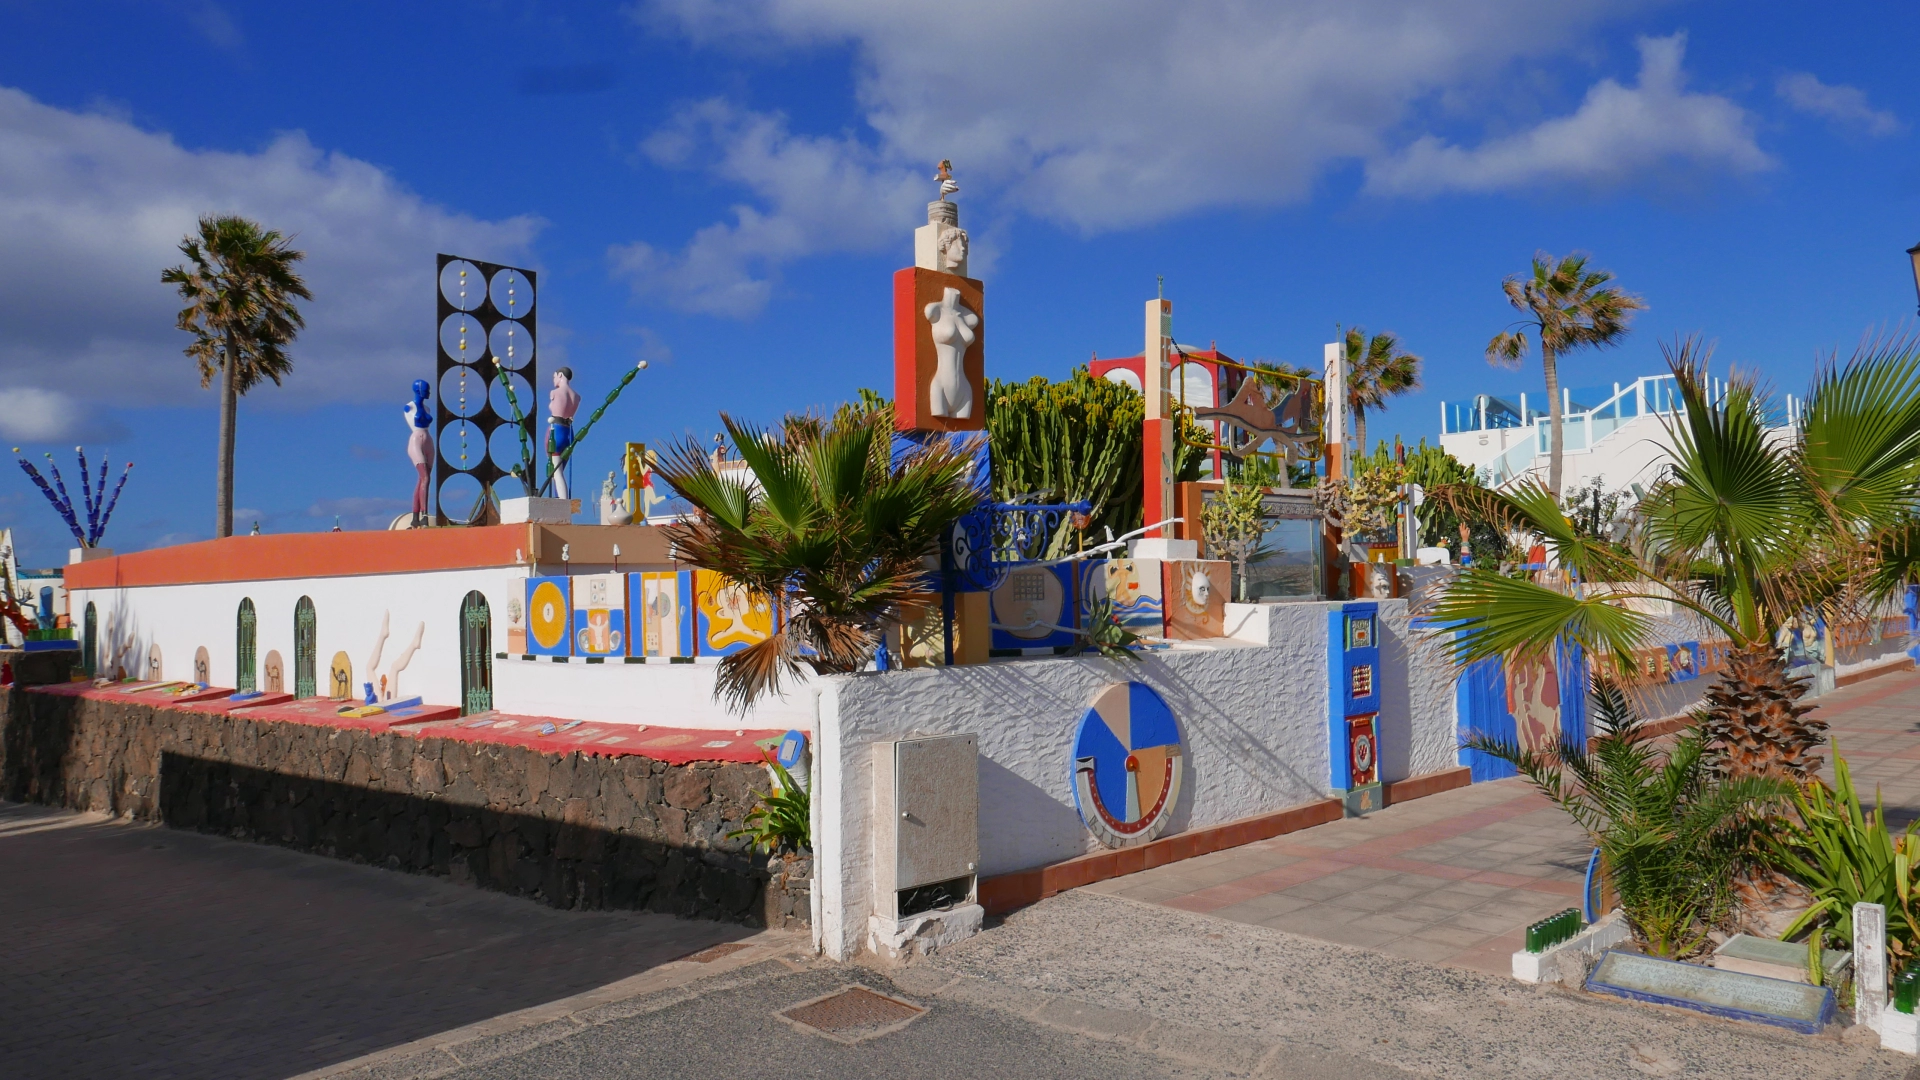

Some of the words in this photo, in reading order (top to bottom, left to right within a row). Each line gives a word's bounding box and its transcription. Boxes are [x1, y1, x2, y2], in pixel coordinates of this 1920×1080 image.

[1621, 962, 1640, 970] QUE
[1705, 989, 1730, 998] POR
[1732, 993, 1753, 1002] LOS
